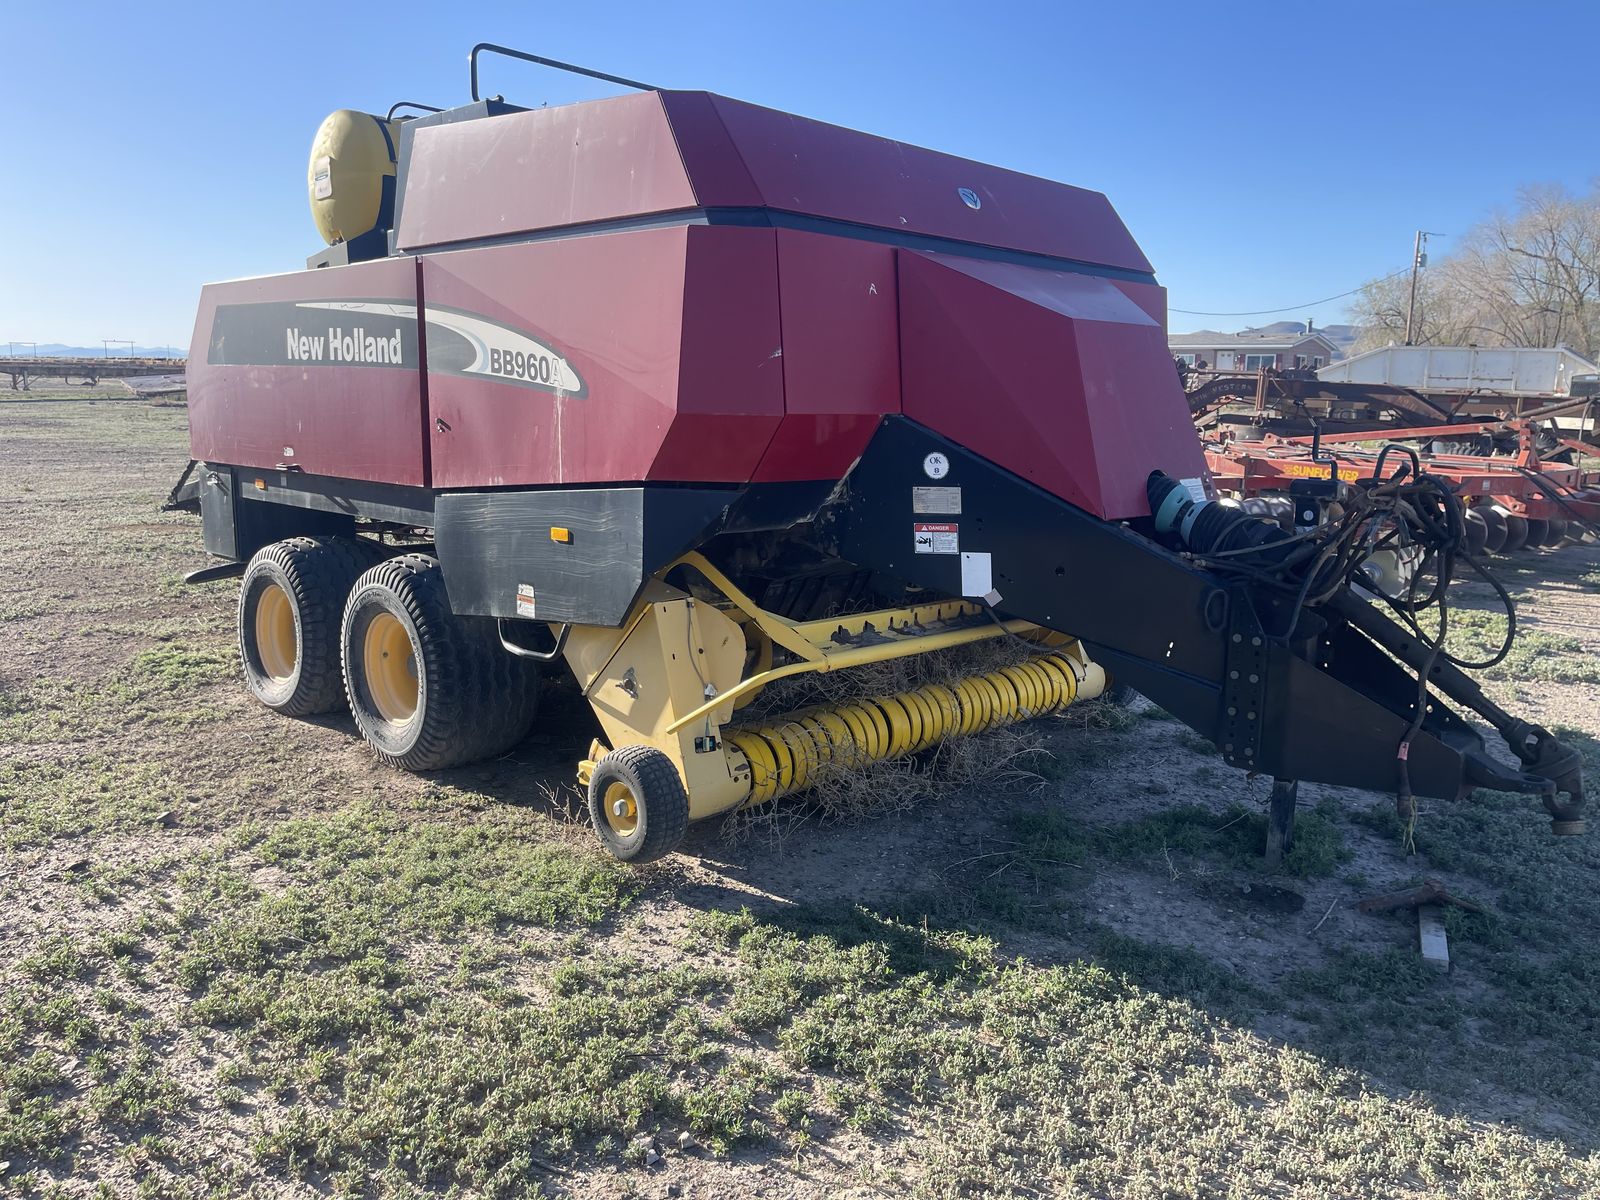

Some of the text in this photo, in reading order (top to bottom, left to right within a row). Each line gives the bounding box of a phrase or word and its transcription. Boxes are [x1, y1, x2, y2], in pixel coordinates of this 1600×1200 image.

[286, 327, 403, 365] New Holland
[929, 456, 942, 465] OK
